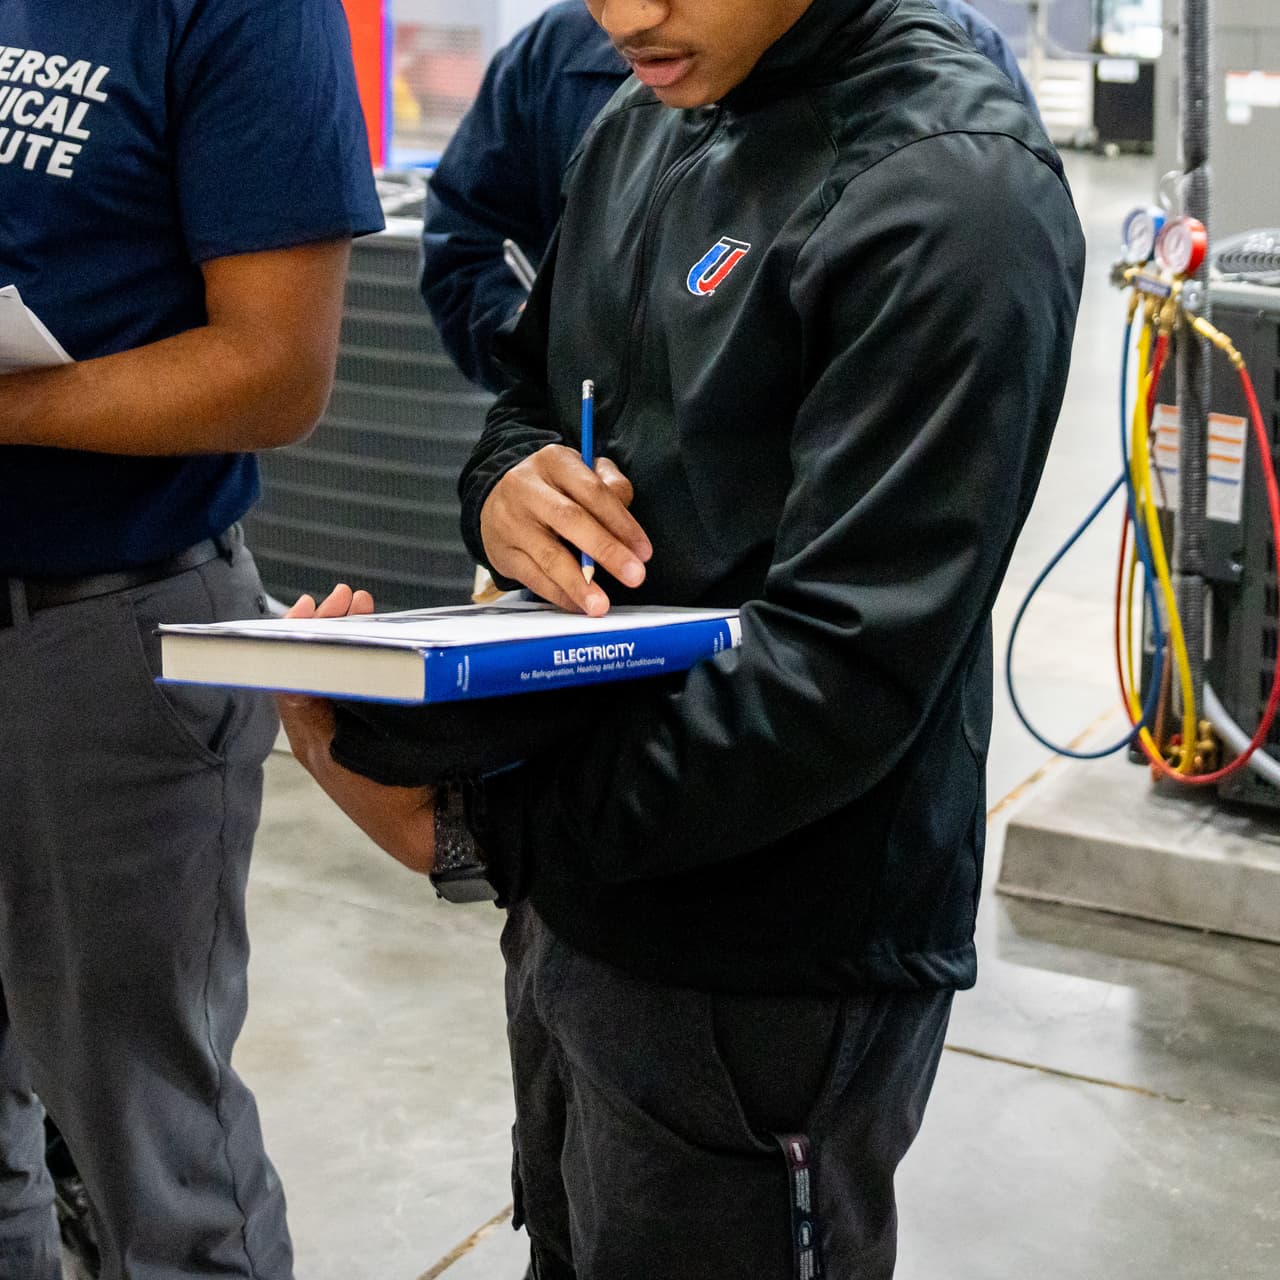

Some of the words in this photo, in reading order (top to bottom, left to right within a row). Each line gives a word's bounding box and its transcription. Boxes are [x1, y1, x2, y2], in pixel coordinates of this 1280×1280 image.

[553, 642, 635, 665] ELECTRICITY
[520, 671, 531, 680] for
[576, 663, 602, 674] Heating
[602, 662, 614, 671] and
[615, 660, 625, 669] Air
[626, 656, 665, 668] Conditioning
